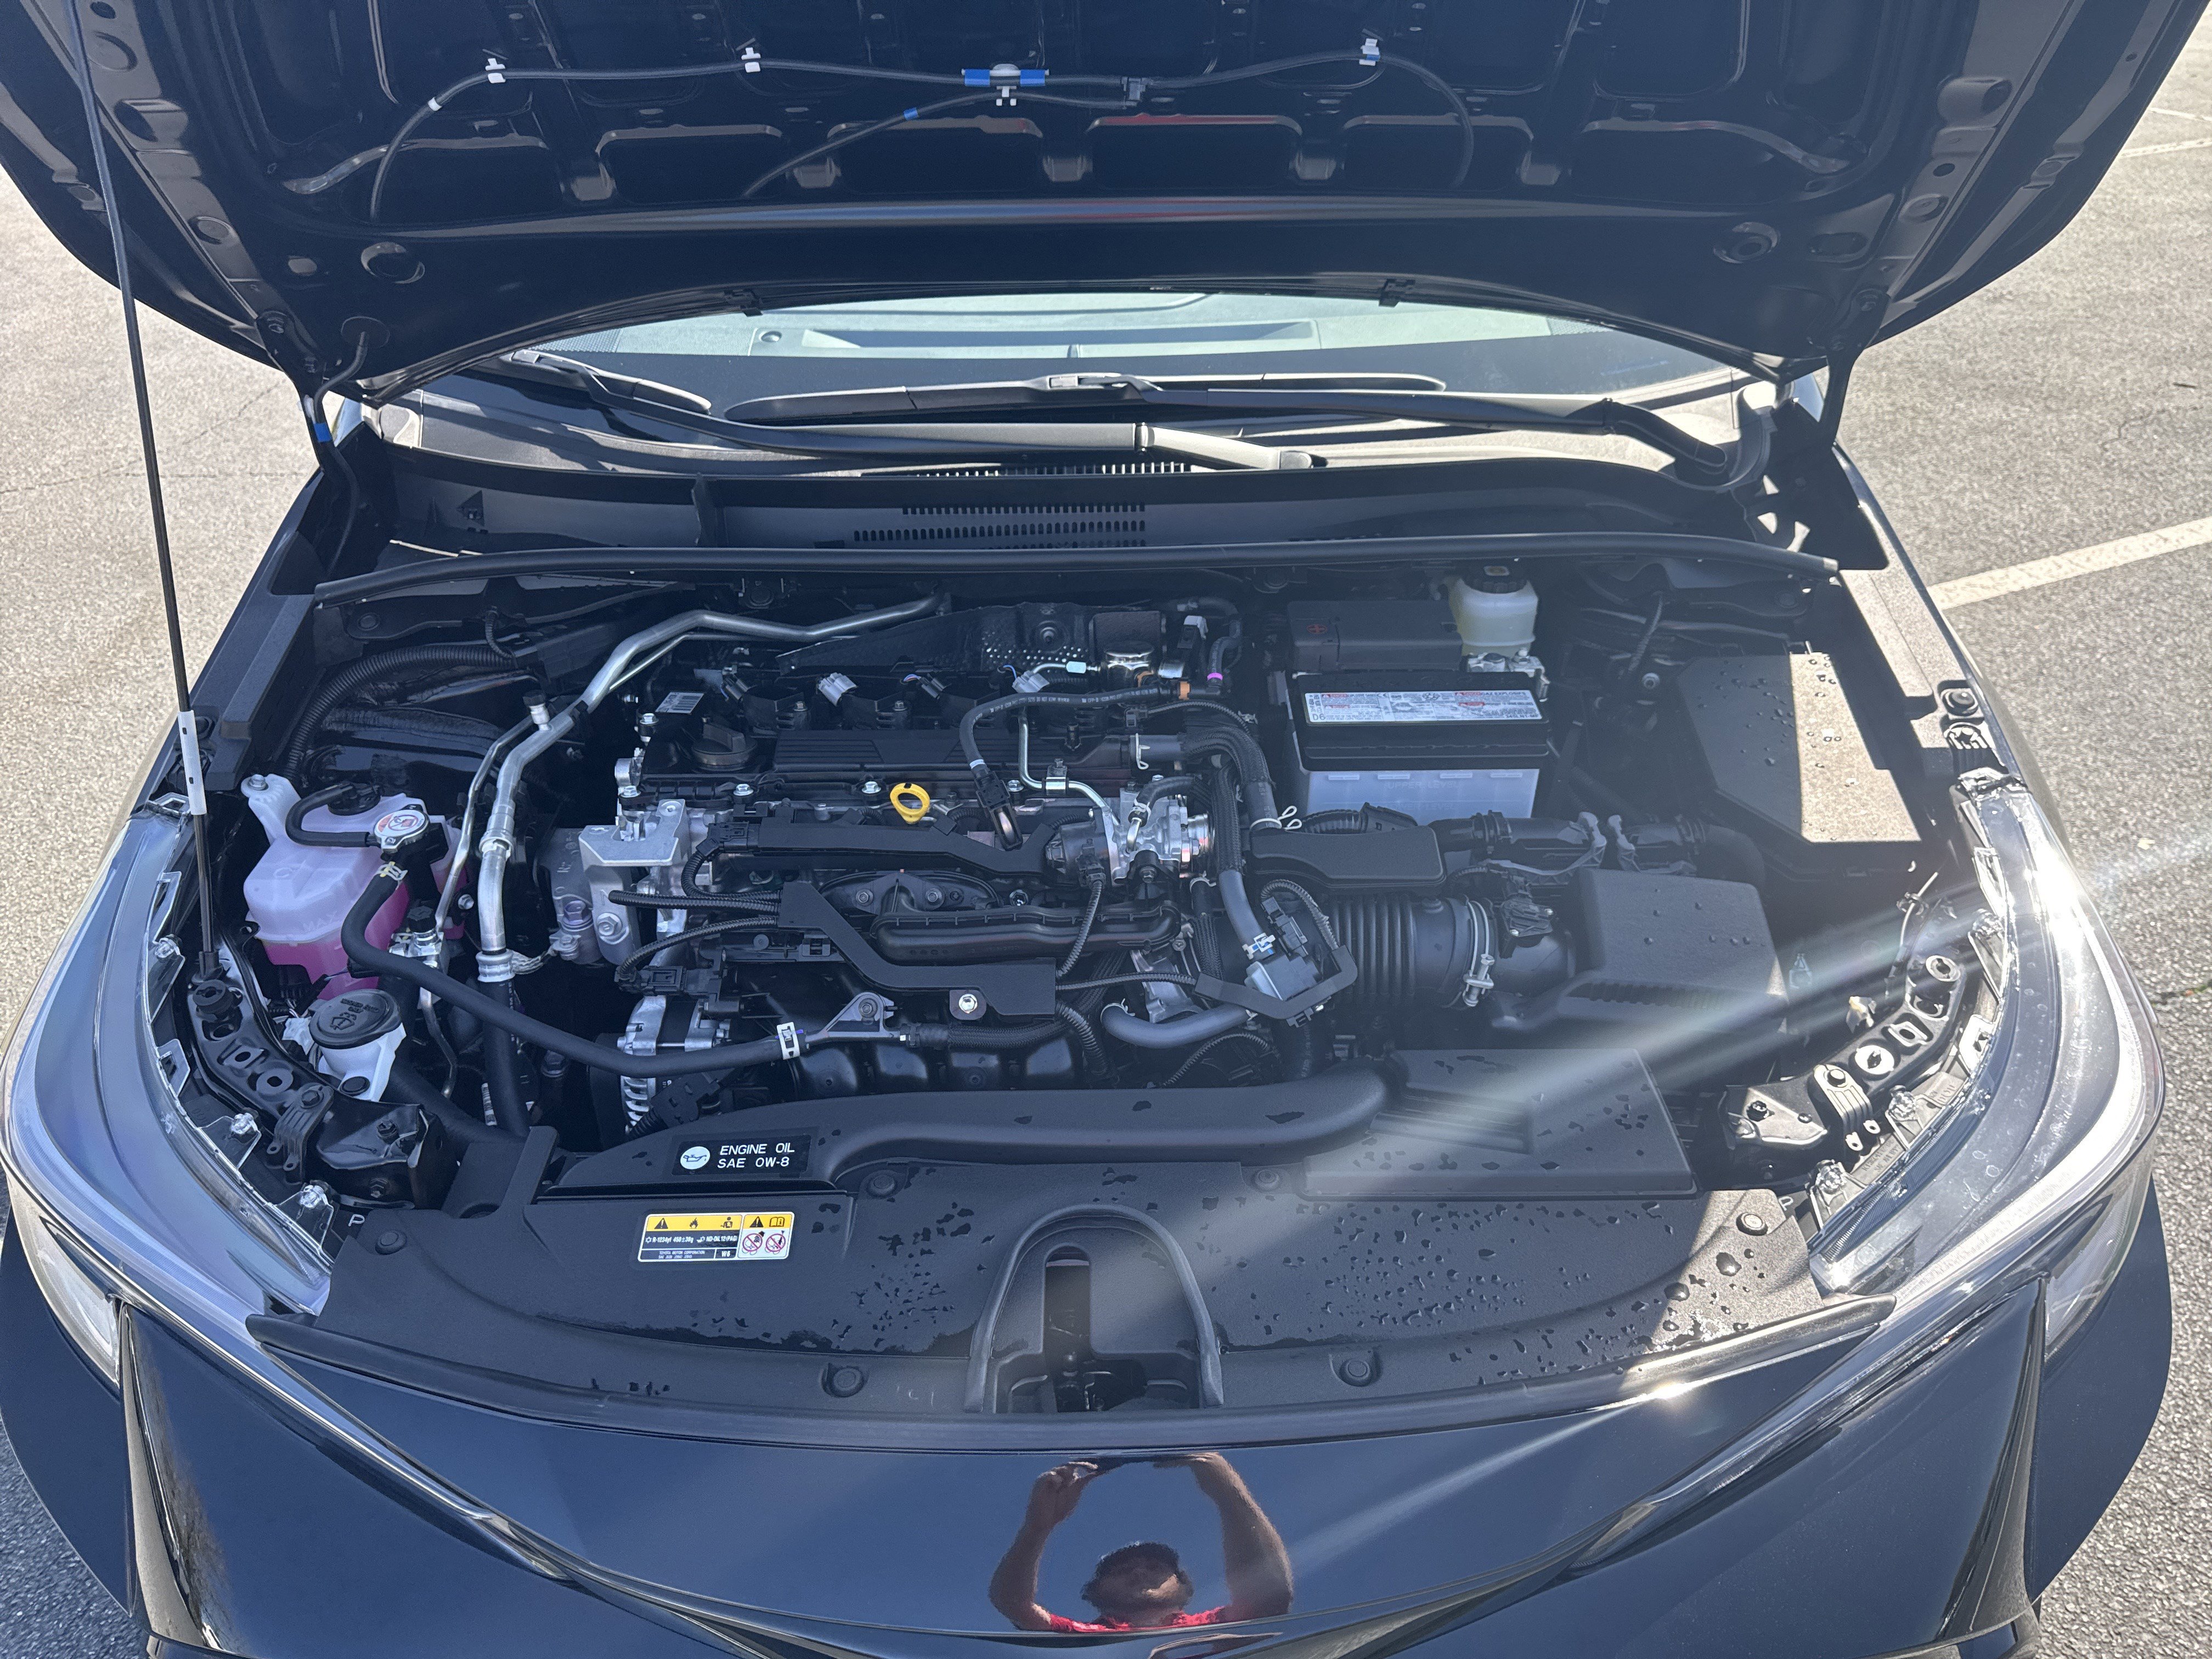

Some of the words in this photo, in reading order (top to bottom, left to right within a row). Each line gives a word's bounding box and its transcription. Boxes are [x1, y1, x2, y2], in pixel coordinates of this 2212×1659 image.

[720, 1143, 768, 1155] ENGINE
[775, 1142, 795, 1153] OIL
[717, 1158, 747, 1169] SAE
[755, 1156, 790, 1167] 0W-8
[348, 1214, 365, 1227] P
